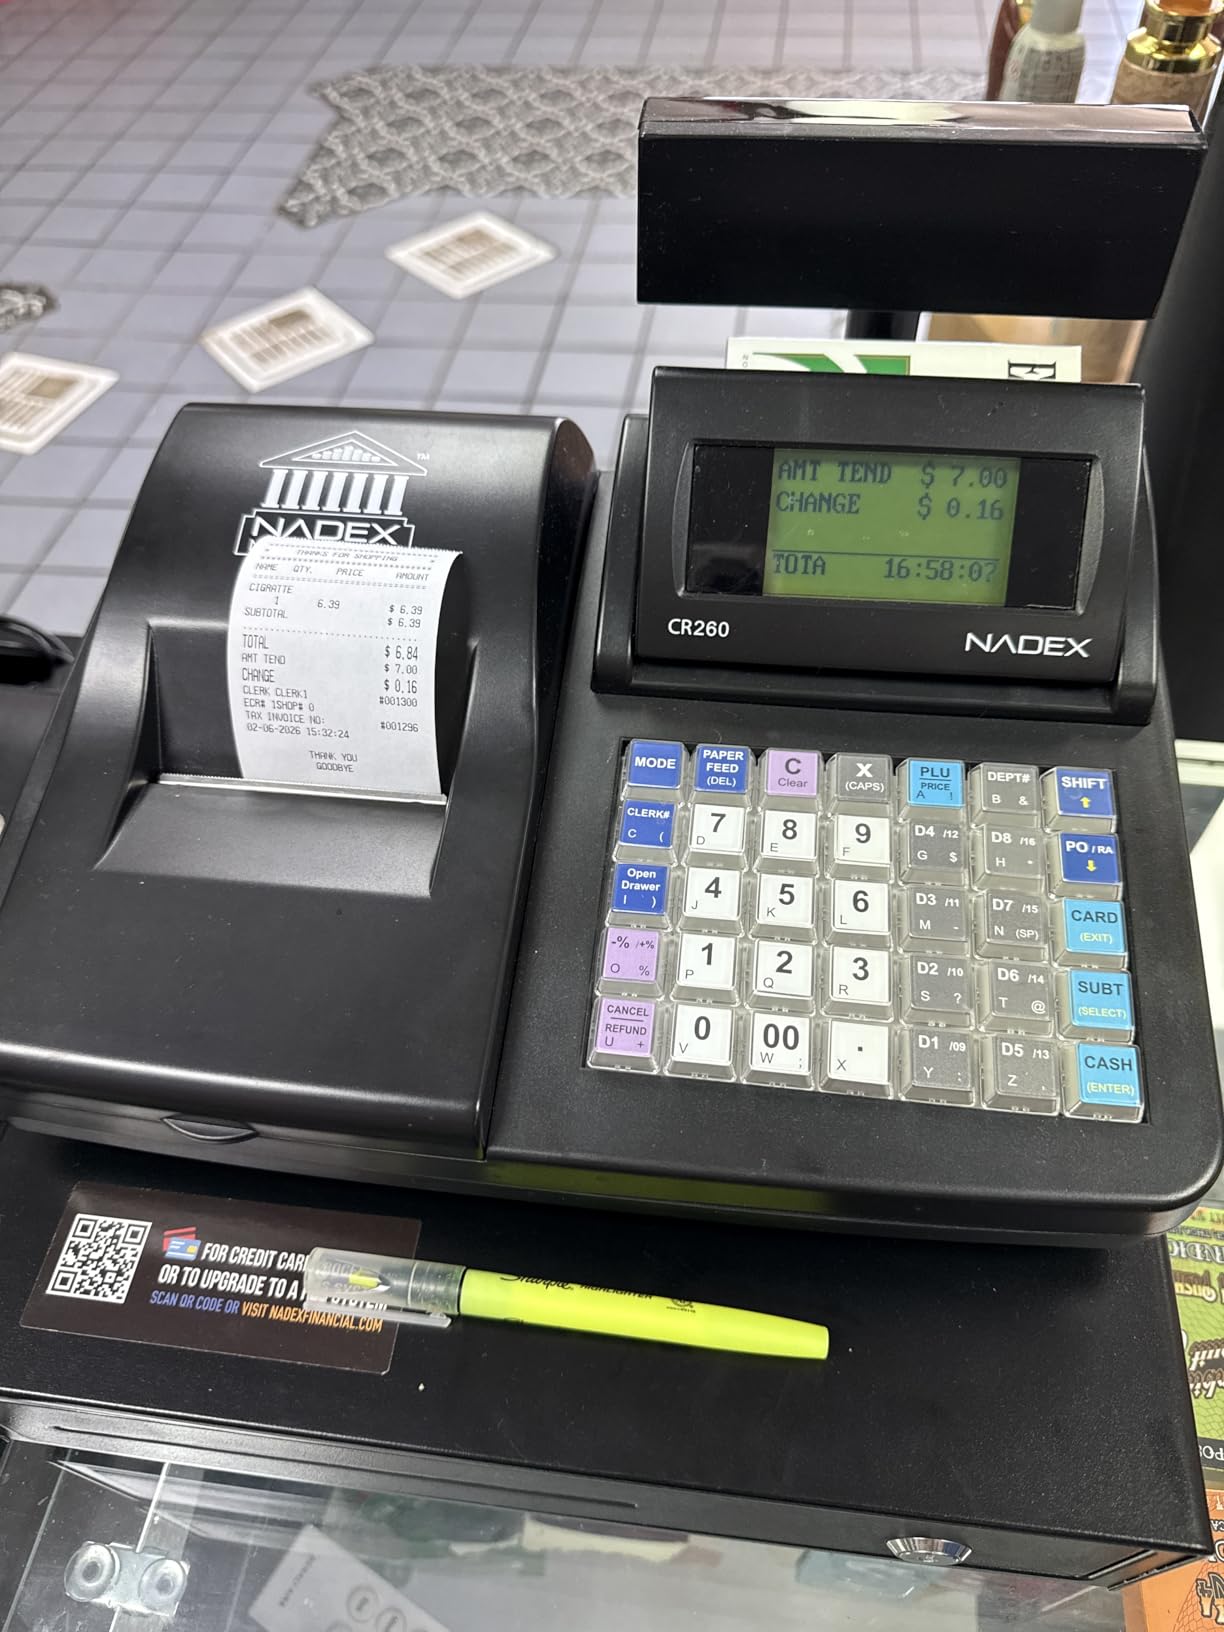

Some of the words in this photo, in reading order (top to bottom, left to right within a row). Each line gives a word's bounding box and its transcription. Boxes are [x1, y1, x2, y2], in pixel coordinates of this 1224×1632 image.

[777, 461, 821, 481] AMT
[837, 461, 893, 484] TEND
[920, 461, 936, 489] $
[951, 466, 1008, 489] 7.00
[775, 490, 861, 515] CHANGE
[917, 492, 933, 520] $
[946, 497, 1004, 520] 0.16
[252, 515, 401, 545] NADEX
[297, 549, 329, 557] THANKS
[332, 551, 350, 559] FOR
[354, 552, 399, 562] SHOPPING
[255, 562, 279, 571] NAME
[292, 564, 313, 574] QTY.
[336, 567, 365, 577] PRICE
[395, 572, 429, 581] AMOUNT
[772, 553, 827, 576] TOTA
[248, 582, 294, 594] CIGRATTE
[317, 598, 340, 610] 6.39
[388, 604, 395, 614] $
[399, 604, 423, 615] 6.39
[244, 606, 288, 619] SUBTOTAL
[397, 617, 421, 628] 6.39
[667, 618, 730, 638] CR260
[242, 633, 269, 650] TOTAL
[384, 644, 391, 659] $
[395, 645, 418, 661] 6.84
[964, 632, 1093, 658] NADEX
[241, 652, 258, 663] AMT
[263, 653, 286, 665] TEND
[383, 663, 390, 673] $
[395, 663, 418, 675] 7.00
[241, 667, 276, 683] CHANGE
[383, 678, 390, 692] $
[394, 678, 418, 694] 0.16
[242, 684, 271, 697] CLERK
[275, 687, 308, 699] CLERK1
[379, 695, 418, 708] #001300
[245, 710, 263, 721] TAX
[267, 711, 305, 724] INVOICE
[309, 715, 325, 725] NO:
[247, 722, 302, 735] 02-06-2026
[306, 727, 350, 739] 15:32:24
[309, 750, 337, 761] THANK
[341, 752, 358, 763] YOU
[703, 750, 744, 761] PAPER
[316, 761, 355, 773] GOODBYE
[634, 756, 677, 770] MODE
[706, 763, 739, 774] FEED
[784, 757, 802, 776] C
[855, 762, 873, 778] X
[920, 766, 950, 778] PLU
[987, 771, 1031, 783] DEPT#
[706, 776, 737, 788] (DEL)
[777, 777, 808, 788] Clear
[845, 781, 885, 794] (CAPS)
[921, 782, 950, 791] PRICE
[1061, 775, 1108, 790] SHIFT
[915, 790, 925, 799] A
[991, 794, 1001, 804] B
[627, 807, 670, 819] CLERK#
[710, 812, 726, 833] 7
[782, 818, 798, 840] 8
[627, 828, 637, 839] C
[855, 822, 871, 844] 9
[914, 825, 935, 837] D4
[942, 830, 959, 839] /12
[991, 831, 1012, 844] D8
[696, 835, 706, 845] D
[770, 842, 779, 852] E
[1065, 840, 1088, 853] PO
[842, 846, 851, 856] F
[917, 850, 928, 860] G
[995, 857, 1006, 867] H
[627, 868, 657, 880] Open
[621, 880, 661, 891] Drawer
[704, 877, 722, 899] 4
[778, 883, 795, 906] 5
[852, 890, 869, 912] 6
[916, 892, 937, 906] D3
[691, 900, 698, 910] J
[767, 907, 776, 917] K
[992, 898, 1014, 912] D7
[1022, 903, 1039, 914] /15
[840, 915, 848, 925] L
[1071, 909, 1118, 924] CARD
[919, 919, 931, 931] M
[994, 925, 1005, 936] N
[1015, 928, 1039, 941] (SP)
[1079, 931, 1113, 944] (EXIT)
[701, 942, 713, 965] 1
[775, 950, 793, 974] 2
[852, 956, 869, 981] 3
[685, 969, 695, 979] P
[917, 962, 939, 975] D2
[947, 967, 964, 977] /10
[998, 968, 1019, 982] D6
[1027, 973, 1045, 984] /14
[763, 977, 775, 989] Q
[838, 984, 849, 995] R
[1078, 980, 1123, 996] SUBT
[920, 990, 931, 1001] S
[606, 1004, 649, 1017] CANCEL
[998, 997, 1009, 1009] T
[1031, 1000, 1046, 1014] @
[1078, 1006, 1127, 1019] (SELECT)
[605, 1023, 647, 1035] REFUND
[694, 1015, 711, 1040] 0
[605, 1036, 614, 1047] U
[763, 1023, 799, 1050] 00
[918, 1035, 939, 1049] D1
[949, 1041, 966, 1052] /09
[679, 1042, 689, 1054] V
[1001, 1042, 1024, 1057] D5
[1032, 1048, 1050, 1060] /13
[760, 1052, 774, 1064] W
[837, 1058, 847, 1071] X
[1084, 1055, 1132, 1071] CASH
[923, 1066, 934, 1078] Y
[1007, 1074, 1018, 1087] Z
[1087, 1082, 1135, 1095] (ENTER)
[201, 1242, 229, 1262] FOR
[229, 1246, 279, 1268] CREDIT
[157, 1263, 181, 1285] OR
[180, 1266, 201, 1287] TO
[200, 1269, 267, 1295] UPGRADE
[267, 1277, 287, 1298] TO
[286, 1280, 299, 1300] A
[150, 1290, 180, 1307] SCAN
[179, 1294, 195, 1308] QR
[195, 1296, 223, 1313] CODE
[224, 1299, 241, 1314] OR
[241, 1301, 269, 1318] VISIT
[268, 1303, 383, 1333] NADEXFINANCIAL.COM
